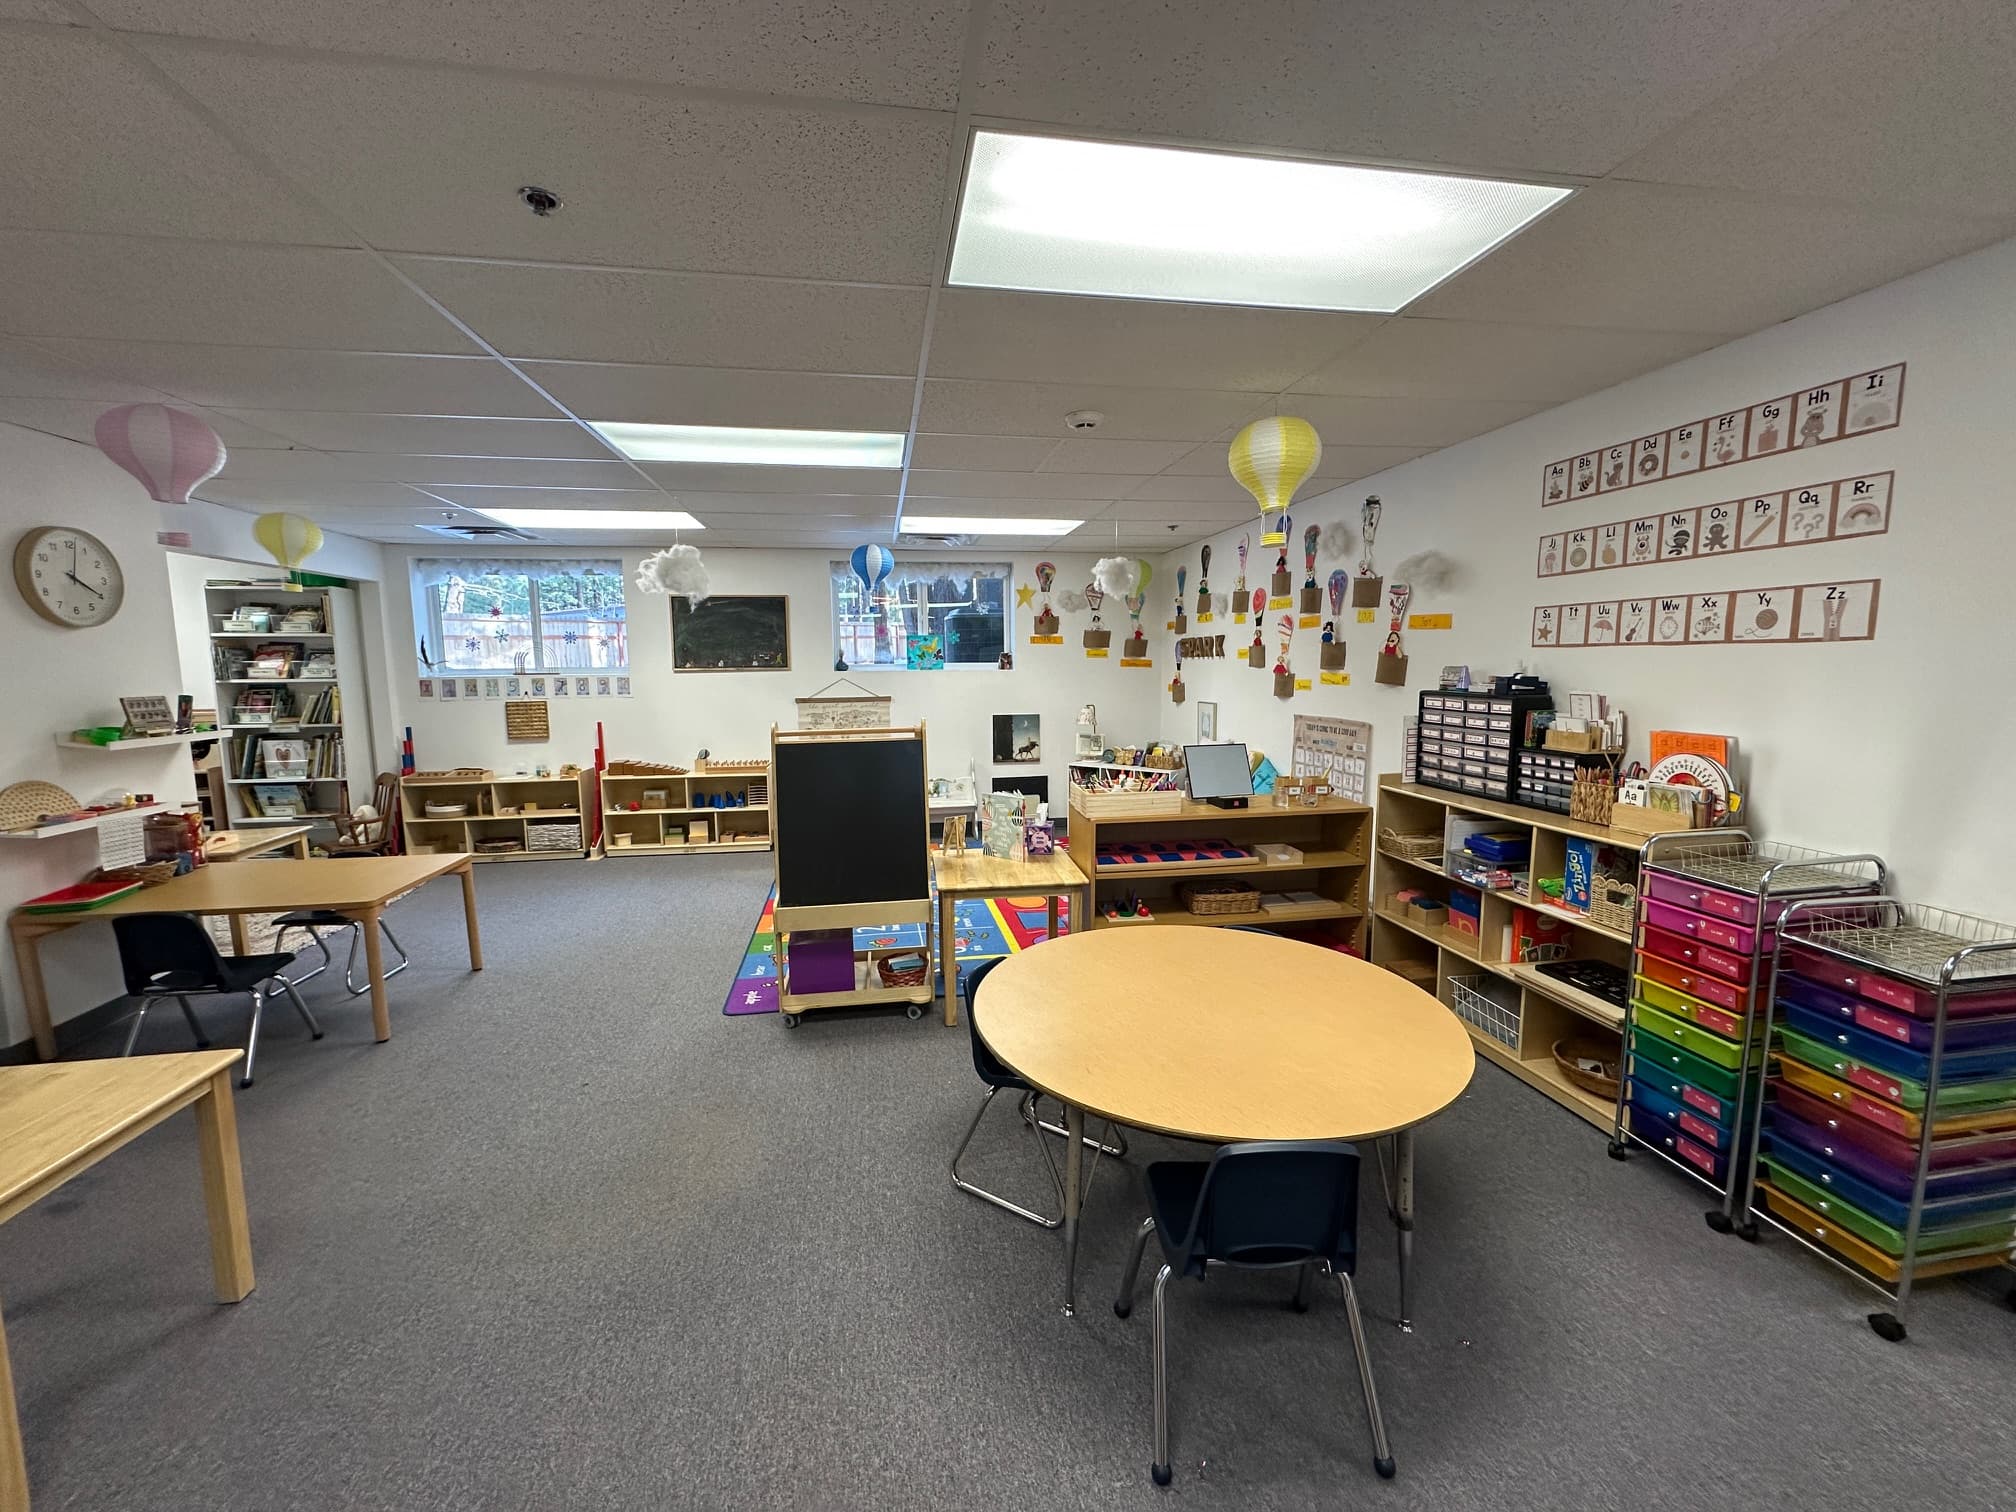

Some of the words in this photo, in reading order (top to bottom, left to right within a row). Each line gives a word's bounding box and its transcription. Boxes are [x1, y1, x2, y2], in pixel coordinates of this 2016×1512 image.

[1551, 466, 1564, 476] Aa
[1579, 457, 1591, 469] Bb
[1610, 449, 1622, 460] Cc
[1643, 438, 1657, 451] Dd
[1678, 428, 1692, 441] Ee
[1718, 415, 1735, 431] Ff
[1762, 405, 1780, 418] Gg
[1808, 389, 1830, 406] Hh
[1866, 374, 1884, 390] Ii
[1549, 538, 1556, 549] Jj
[1573, 532, 1586, 543] Kk
[1606, 527, 1616, 538] Ll
[1634, 521, 1654, 533] Mm
[1671, 514, 1687, 527] Nn
[1710, 507, 1728, 519] Oo
[1754, 500, 1771, 514] Pp
[1798, 490, 1820, 505] Qq
[1853, 481, 1875, 496] Rr
[48, 542, 57, 551] 11
[64, 540, 74, 549] 12
[82, 547, 87, 555] 1
[38, 553, 48, 562] 10
[35, 569, 41, 578] 9
[101, 577, 107, 585] 3
[43, 587, 49, 596] 8
[56, 600, 62, 608] 7
[88, 603, 95, 611] 5
[1542, 609, 1551, 619] Ss
[1568, 606, 1579, 617] Tt
[1598, 605, 1610, 615] Uu
[1630, 603, 1643, 613] Vv
[1661, 600, 1680, 611] Ww
[1701, 597, 1717, 608] Xx
[1757, 592, 1772, 607] Yy
[1826, 587, 1846, 600] Zz
[73, 606, 80, 615] 6
[1180, 635, 1225, 659] SPARK
[507, 680, 517, 692] 5
[535, 679, 544, 692] 6
[556, 680, 565, 692] 7
[578, 679, 586, 692] 8
[600, 679, 607, 692] 9
[1624, 790, 1637, 800] Aa
[1568, 849, 1586, 893] Zingo!
[743, 990, 762, 1005] apple
